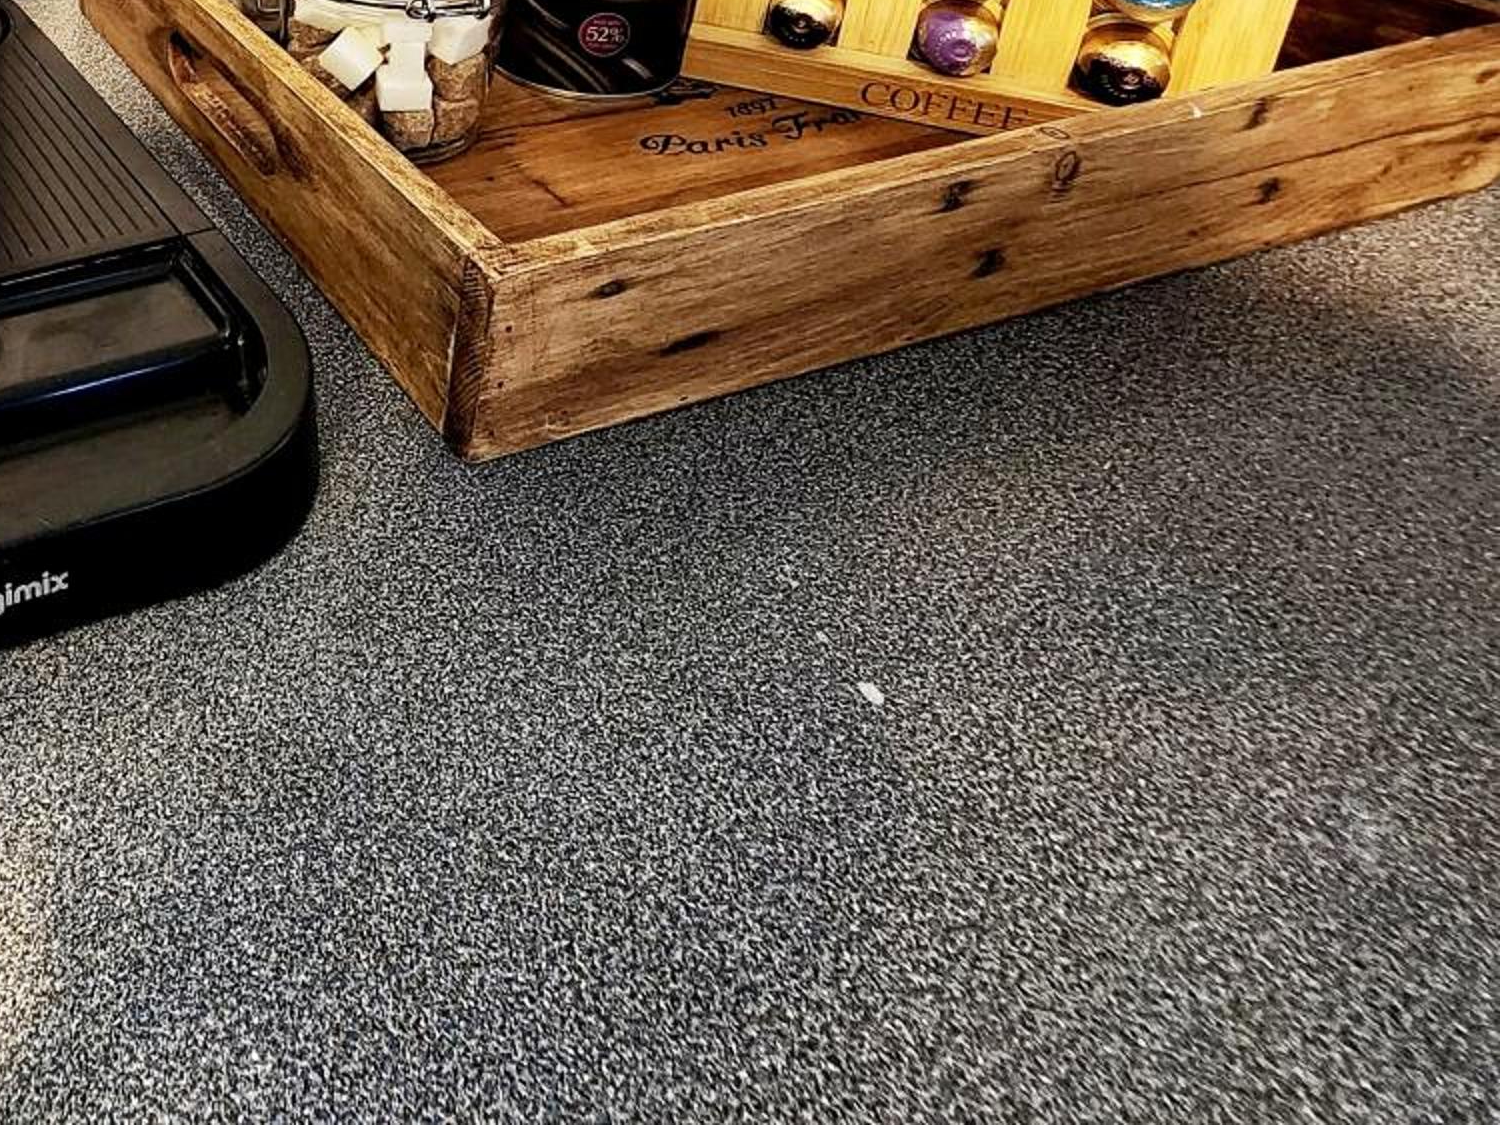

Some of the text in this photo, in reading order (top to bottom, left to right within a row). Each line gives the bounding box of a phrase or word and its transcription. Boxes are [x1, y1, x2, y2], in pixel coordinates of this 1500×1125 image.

[585, 26, 625, 43] 52%
[861, 82, 1029, 129] COFFEE
[639, 130, 769, 156] Paris
